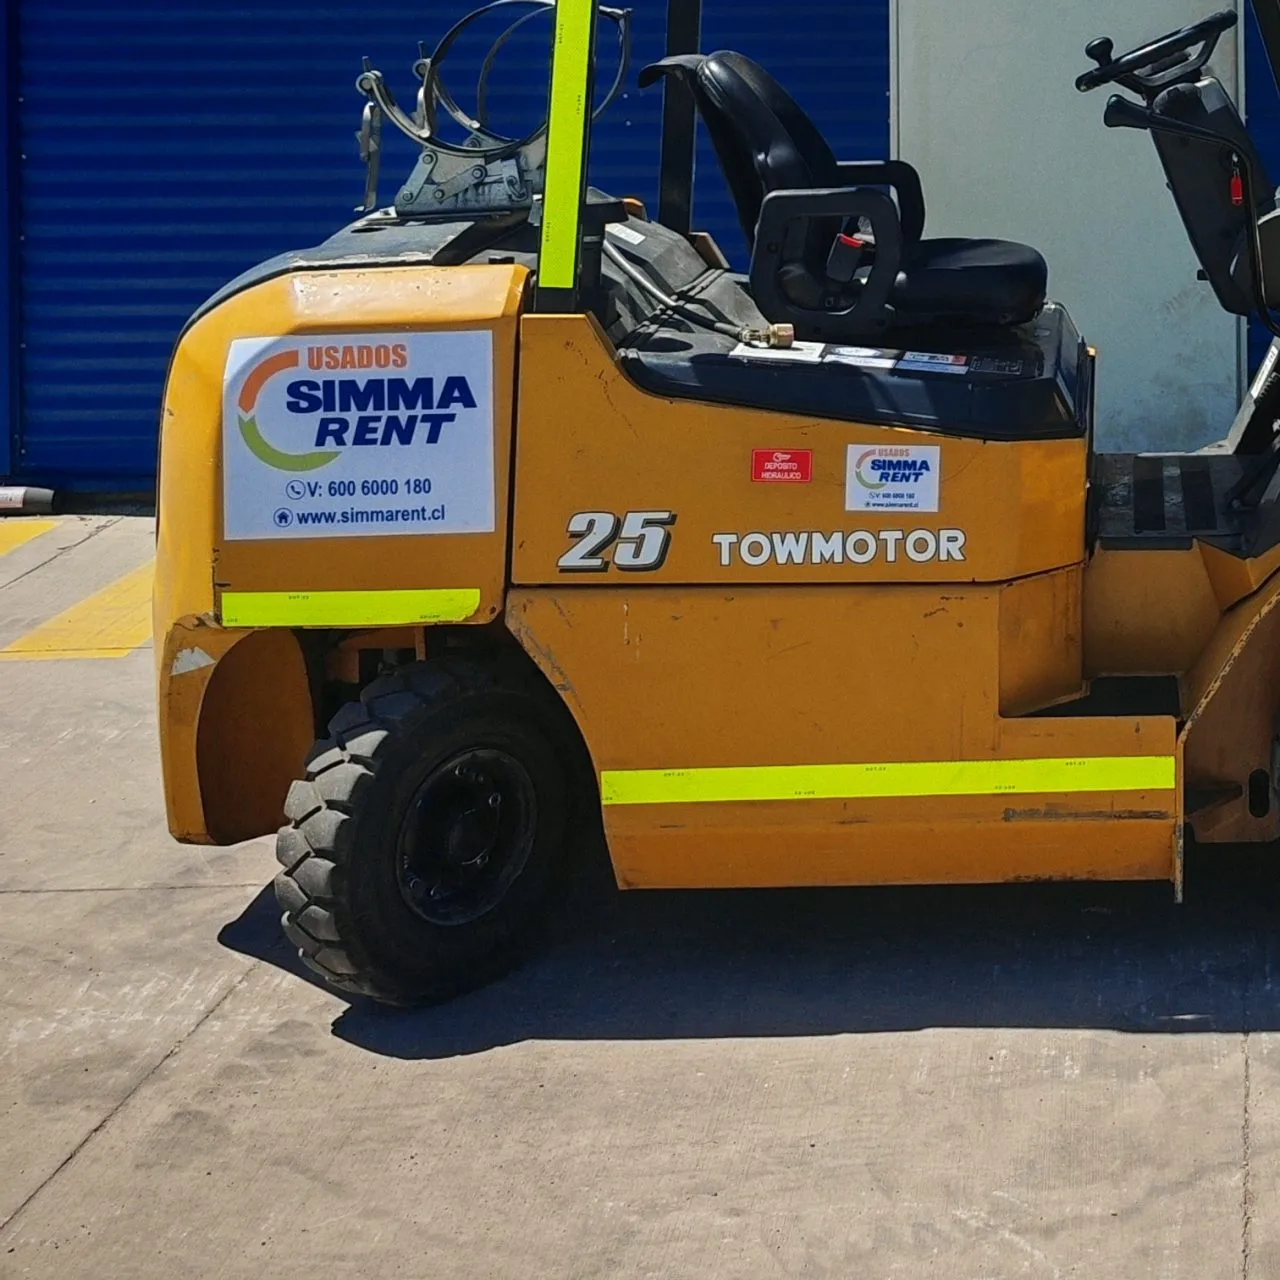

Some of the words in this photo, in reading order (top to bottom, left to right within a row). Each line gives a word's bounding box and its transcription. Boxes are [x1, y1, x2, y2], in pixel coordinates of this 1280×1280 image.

[307, 344, 408, 370] USADOS
[286, 376, 477, 413] SIMMA
[314, 413, 456, 447] RENT
[878, 448, 910, 457] USADOS
[871, 459, 930, 472] SIMMA
[879, 472, 924, 482] RENT
[307, 482, 322, 497] V:
[328, 480, 356, 497] 600
[361, 479, 399, 496] 6000
[404, 478, 432, 495] 180
[297, 504, 445, 525] www.simmarent.cl
[557, 511, 677, 573] 25
[712, 528, 967, 567] TOWMOTOR
